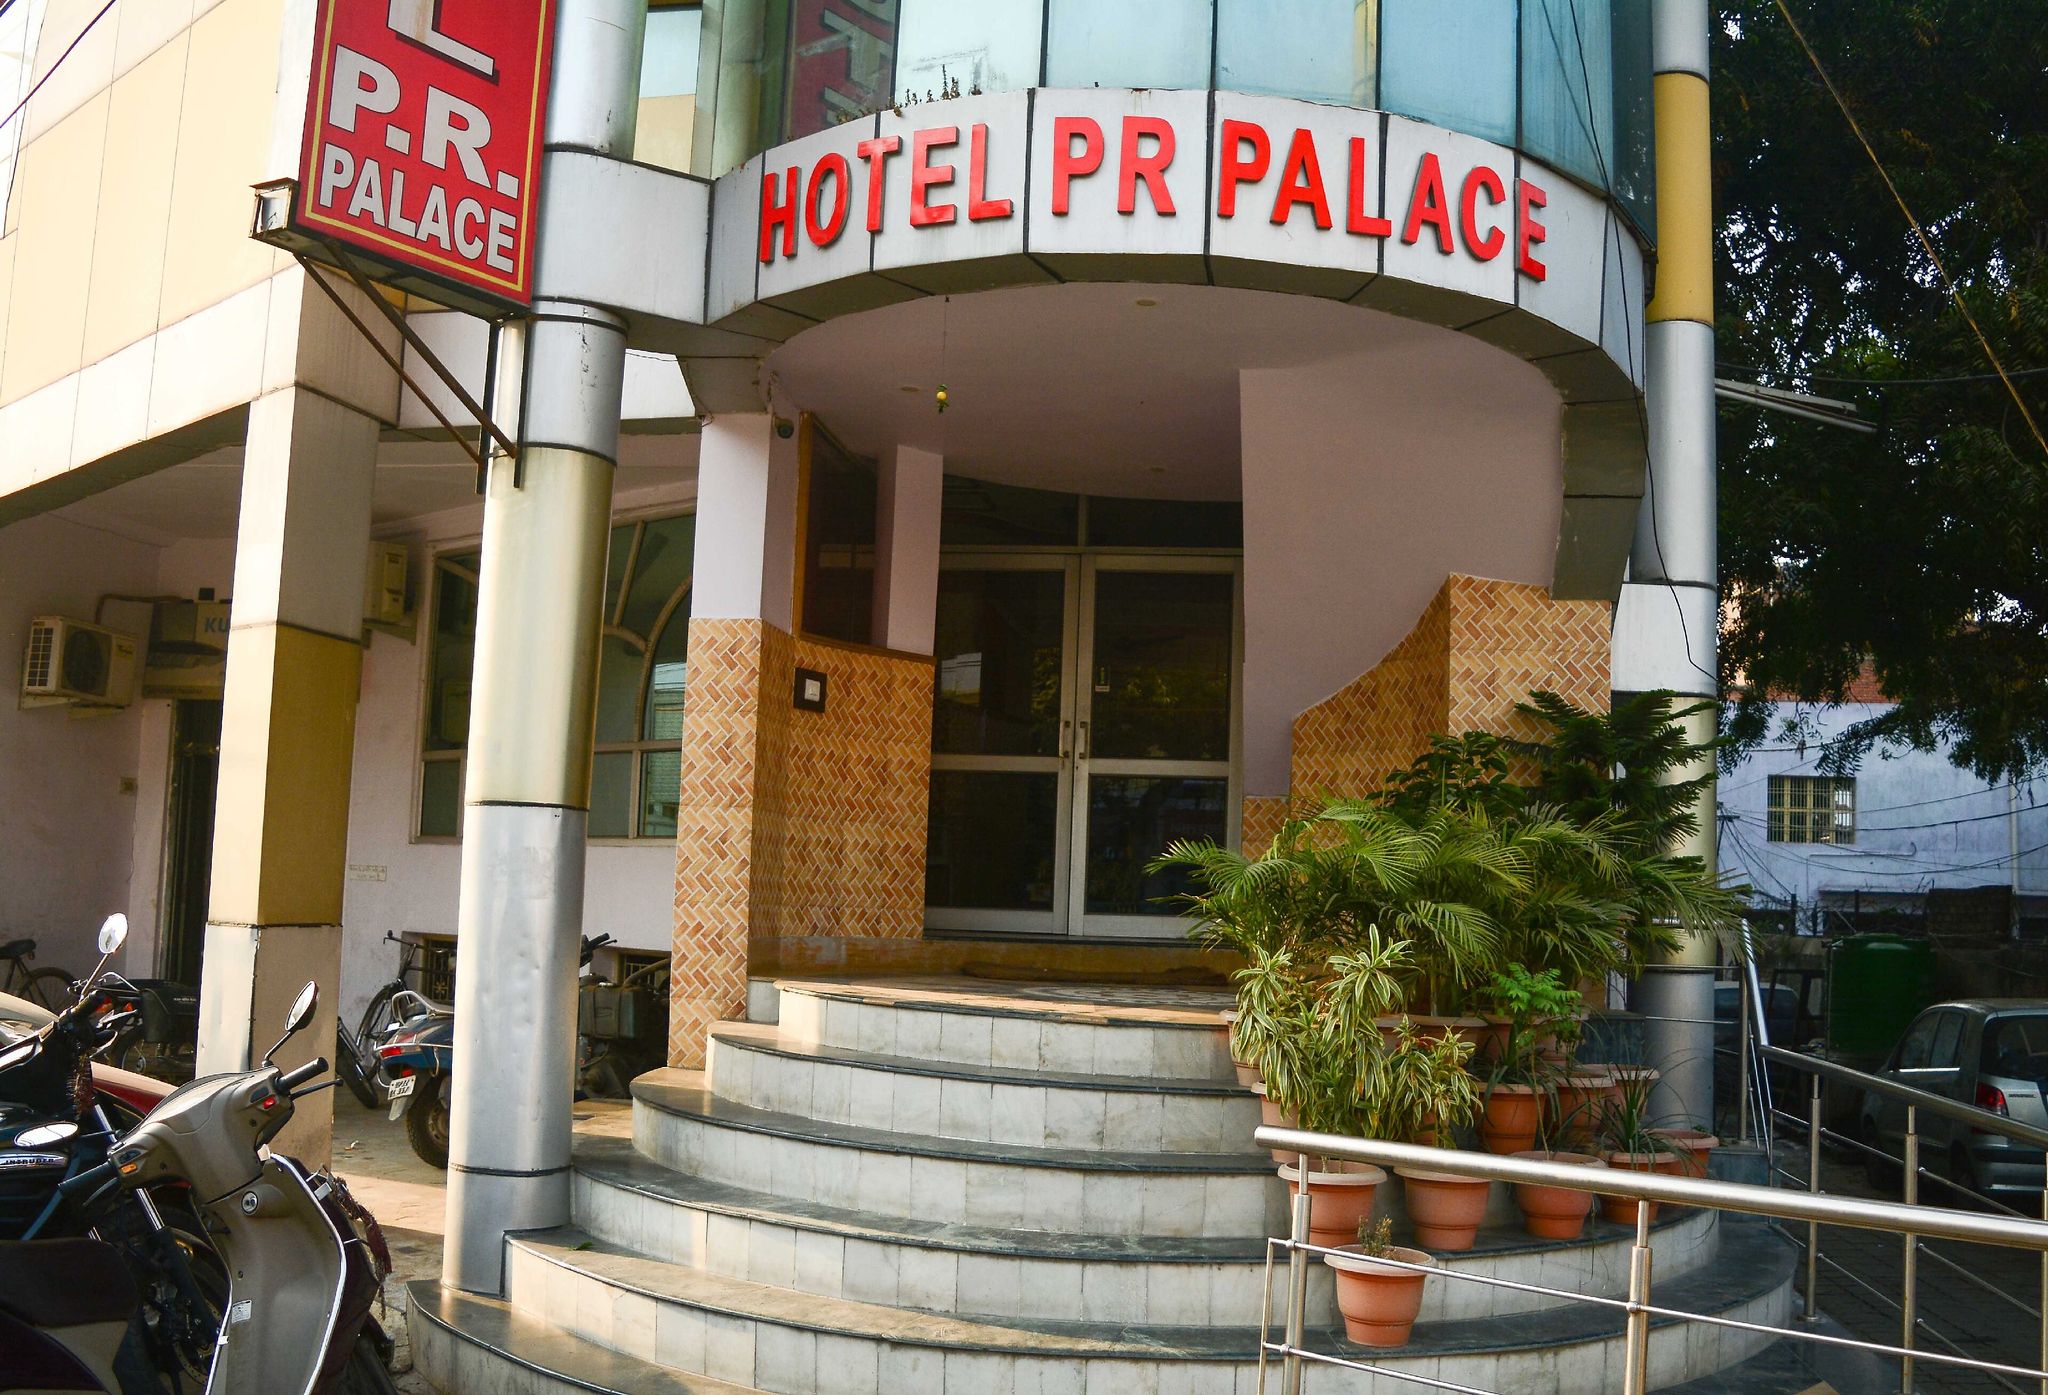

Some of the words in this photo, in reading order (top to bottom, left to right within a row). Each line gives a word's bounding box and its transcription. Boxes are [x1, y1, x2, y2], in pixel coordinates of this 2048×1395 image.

[328, 43, 519, 200] P.R.
[760, 123, 1014, 264] HOTEL
[1051, 116, 1177, 216] PR
[1217, 118, 1547, 282] PALACE
[319, 142, 518, 274] PALACE
